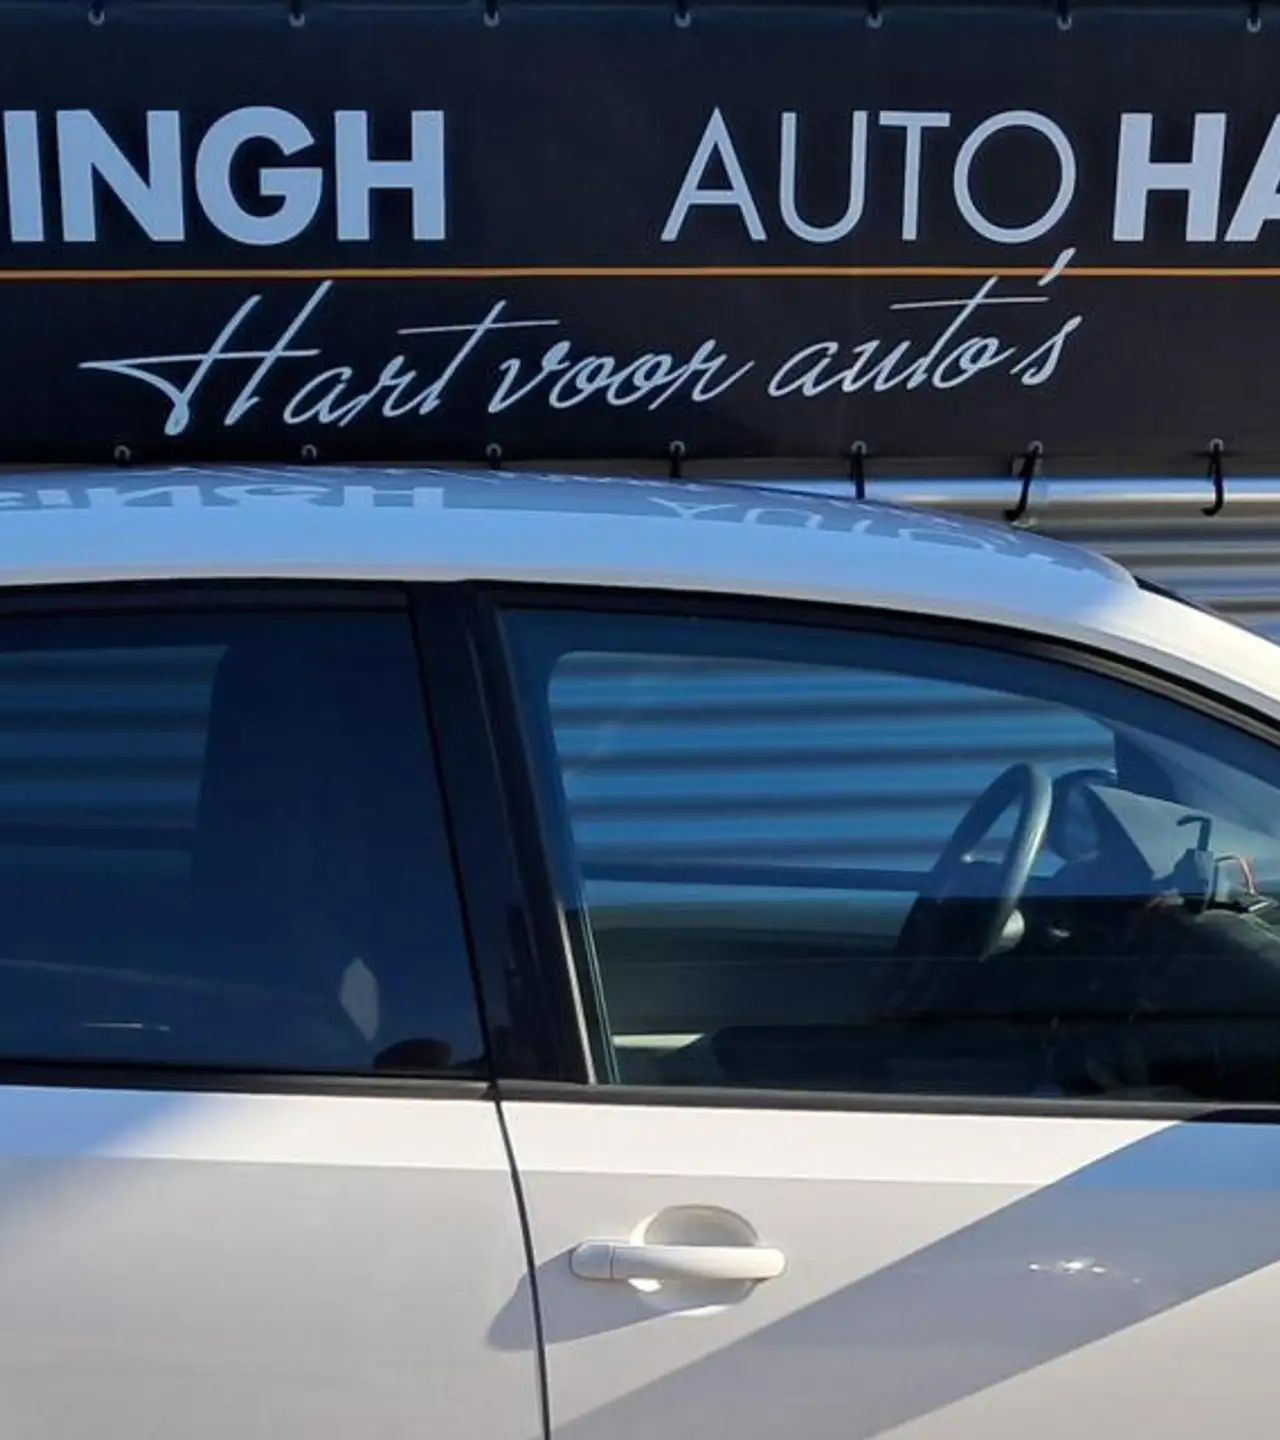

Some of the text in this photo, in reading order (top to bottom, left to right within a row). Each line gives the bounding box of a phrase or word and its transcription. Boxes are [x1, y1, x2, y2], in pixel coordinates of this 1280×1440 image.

[662, 109, 1076, 243] AUTO
[80, 248, 1082, 435] Hart voor auto's
